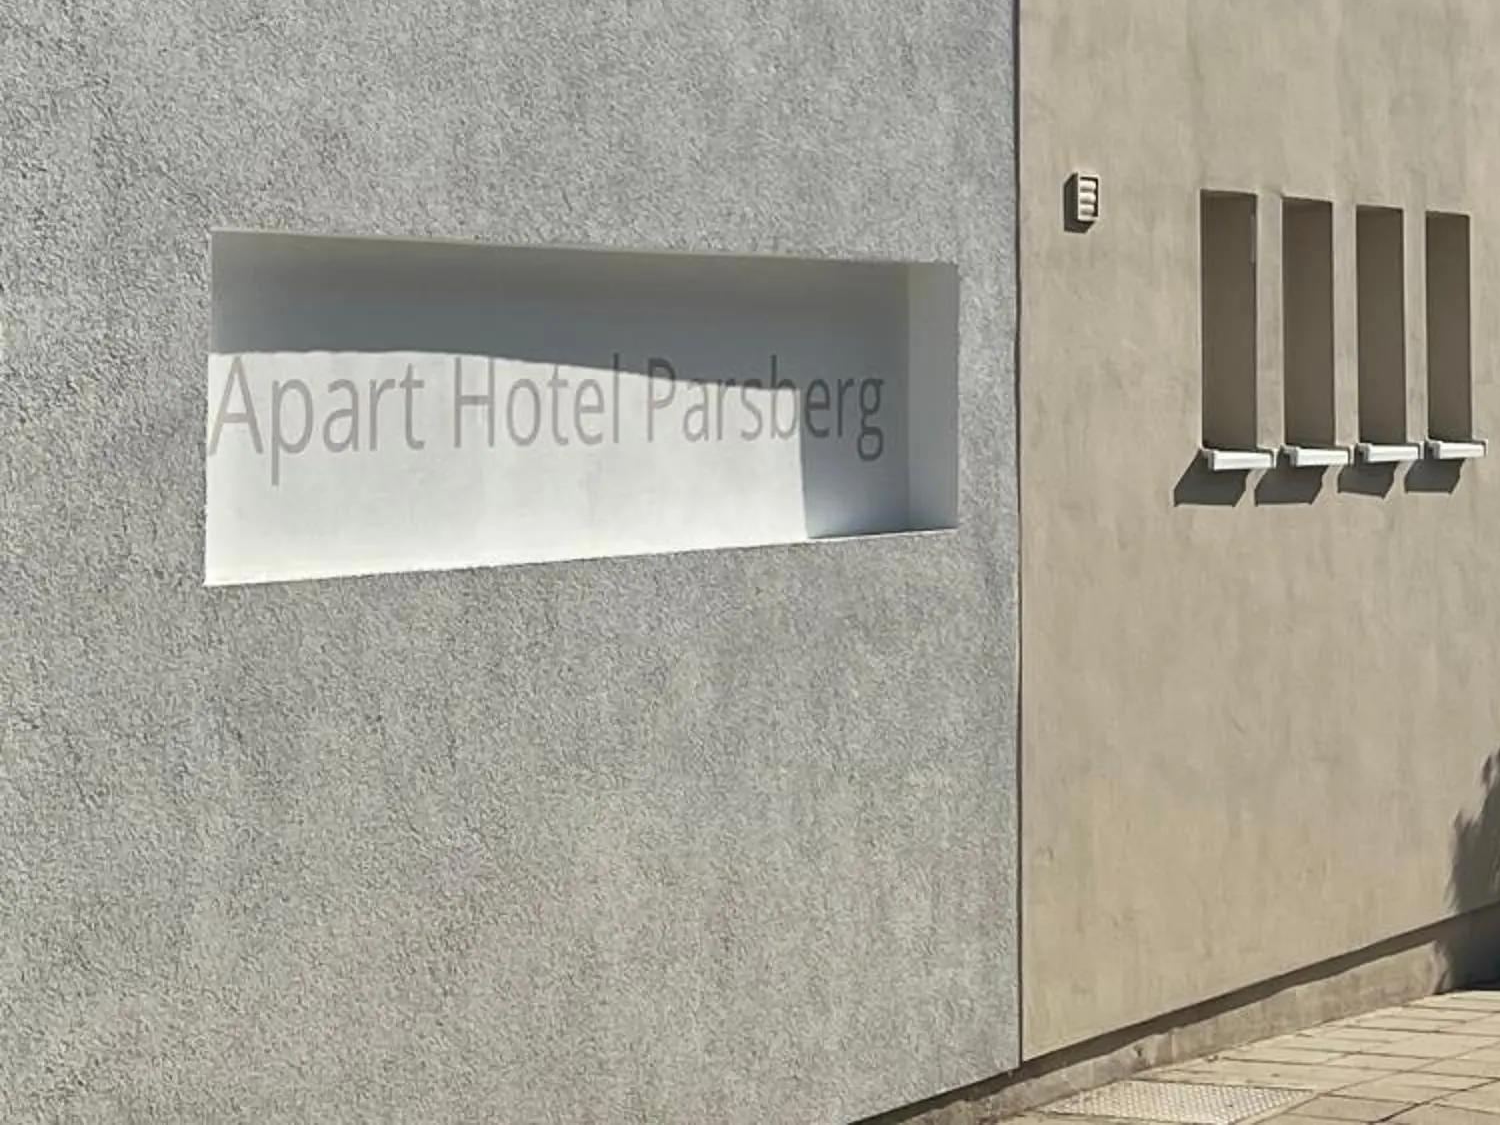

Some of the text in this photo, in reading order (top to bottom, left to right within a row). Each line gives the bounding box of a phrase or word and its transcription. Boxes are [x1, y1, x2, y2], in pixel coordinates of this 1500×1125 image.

[208, 354, 885, 486] Apart Hotel Parsberg
